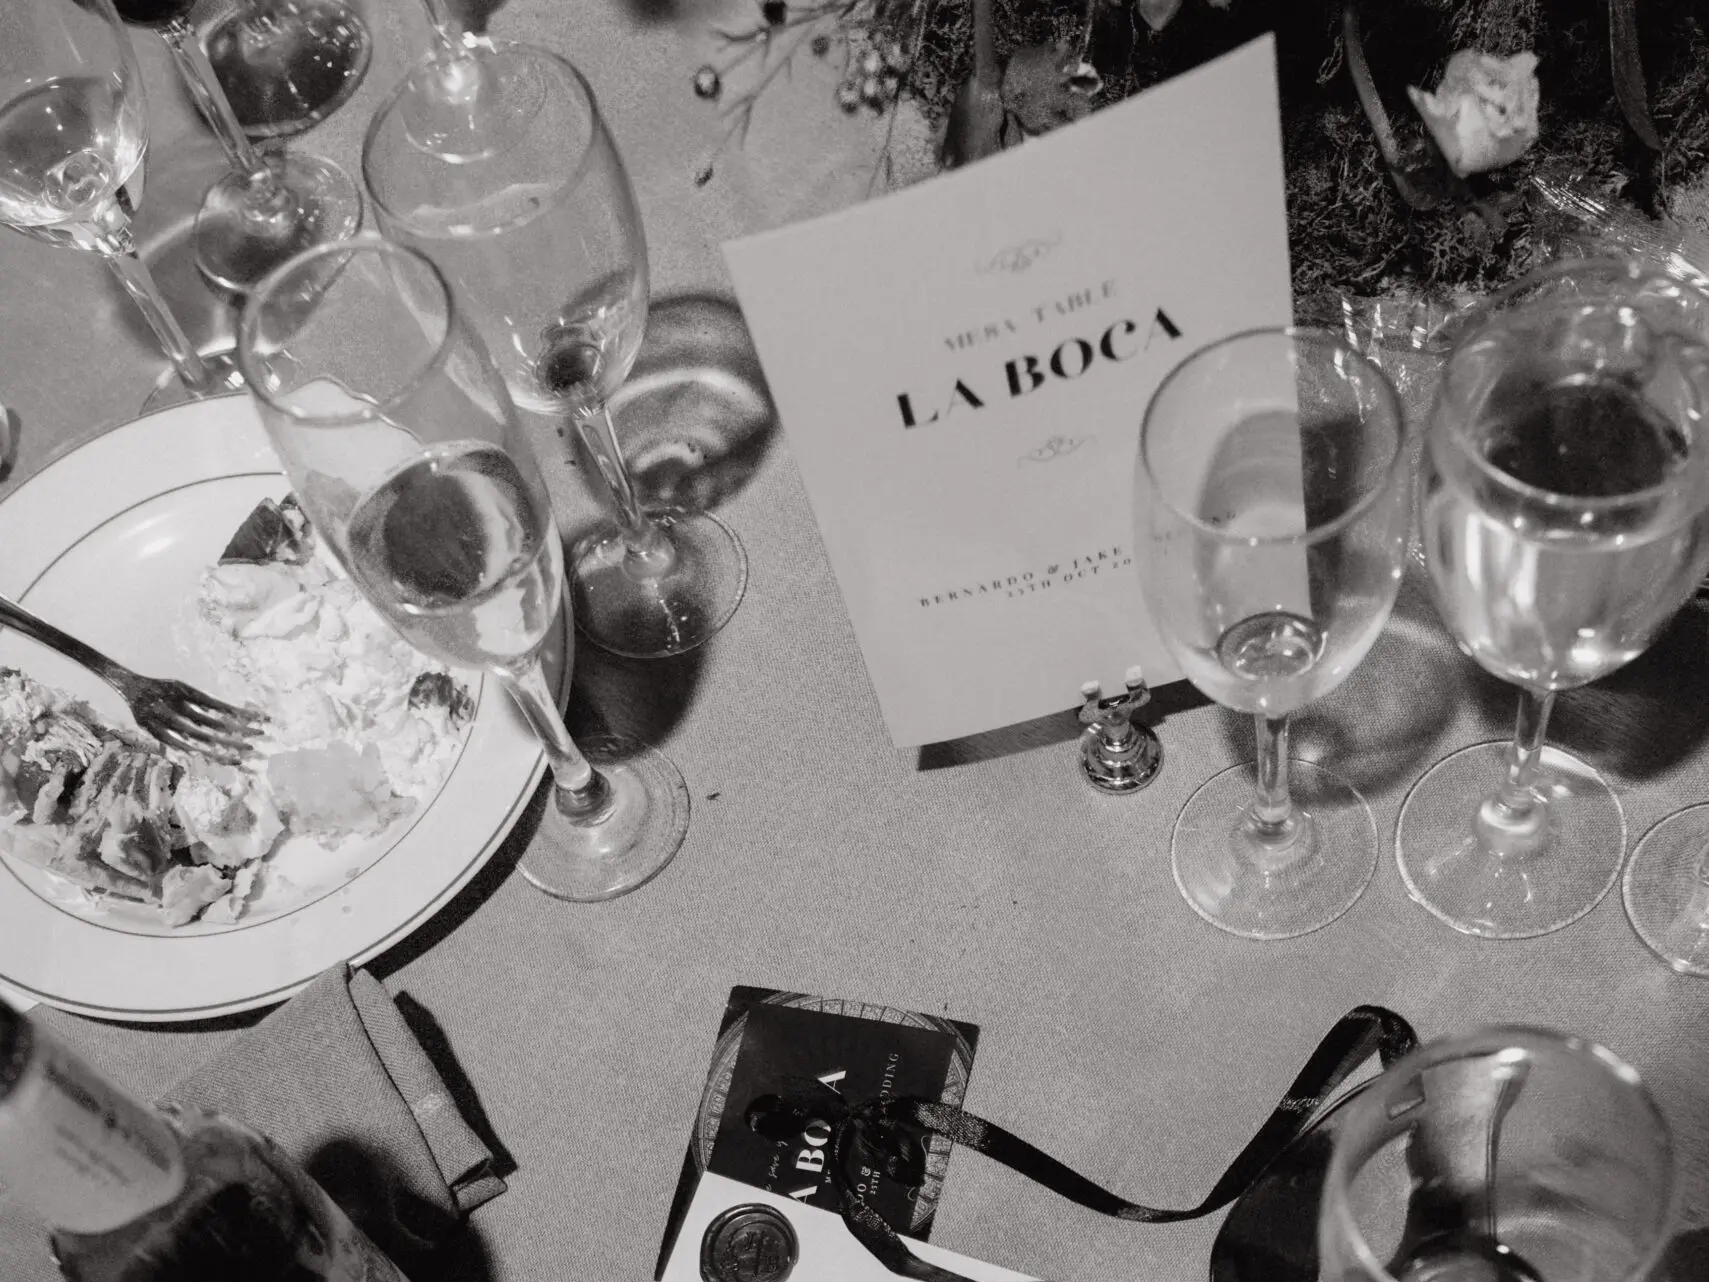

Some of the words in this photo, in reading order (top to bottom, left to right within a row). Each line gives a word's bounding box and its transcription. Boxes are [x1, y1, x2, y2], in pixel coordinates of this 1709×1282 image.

[943, 317, 1017, 351] MESA
[1034, 277, 1118, 323] TABLE
[896, 377, 986, 430] LA
[1005, 305, 1184, 398] BOCA
[919, 571, 1034, 608] BERNARDO
[1046, 563, 1061, 576] &
[1072, 545, 1123, 570] JAKE
[1062, 565, 1100, 584] OCT
[795, 1069, 847, 1173] BOA
